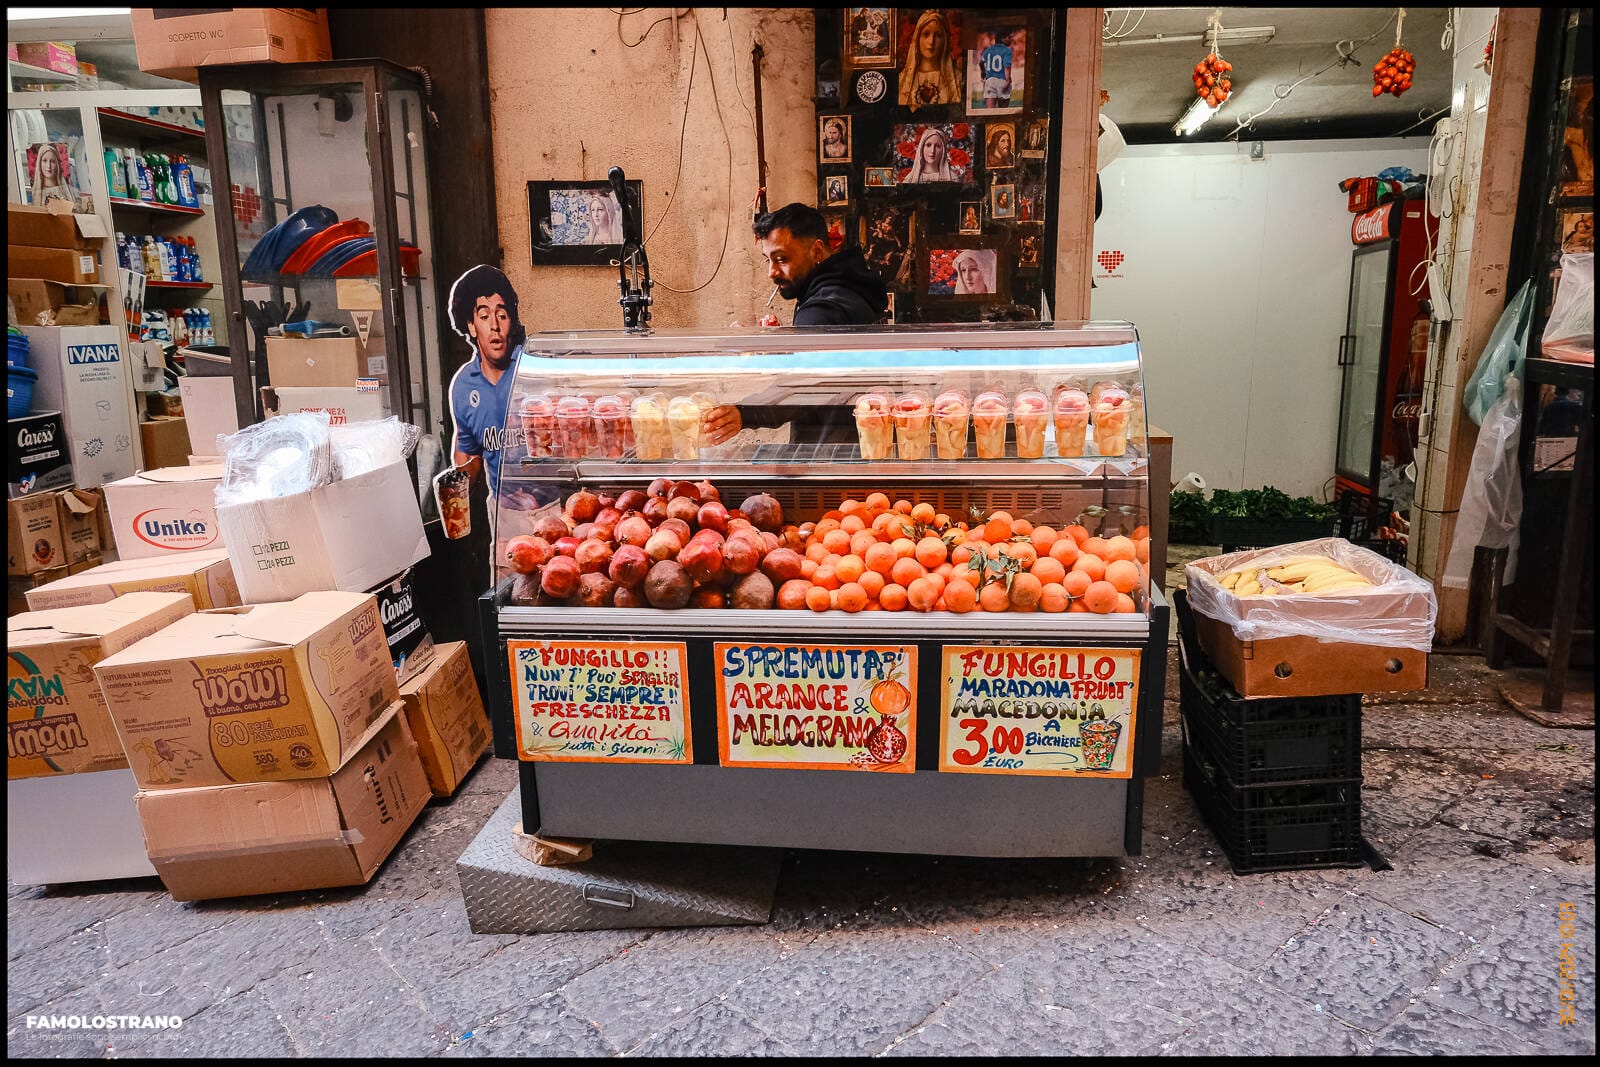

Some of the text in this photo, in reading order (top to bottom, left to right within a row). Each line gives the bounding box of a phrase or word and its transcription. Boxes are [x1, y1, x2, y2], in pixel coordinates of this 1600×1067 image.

[168, 30, 224, 43] SCOPETTO WC
[986, 53, 1002, 72] 10
[69, 345, 118, 363] IVANA
[17, 428, 54, 447] Caress
[144, 520, 206, 537] Uniko
[270, 541, 290, 552] PEZZI
[275, 556, 295, 567] PEZZI
[722, 646, 884, 680] SPREMUTA
[259, 700, 277, 708] poco
[730, 682, 870, 714] ARANCE &
[531, 702, 671, 722] FRESCHEZZA
[214, 720, 250, 747] 80
[1043, 719, 1061, 732] A
[983, 755, 1024, 769] EURO
